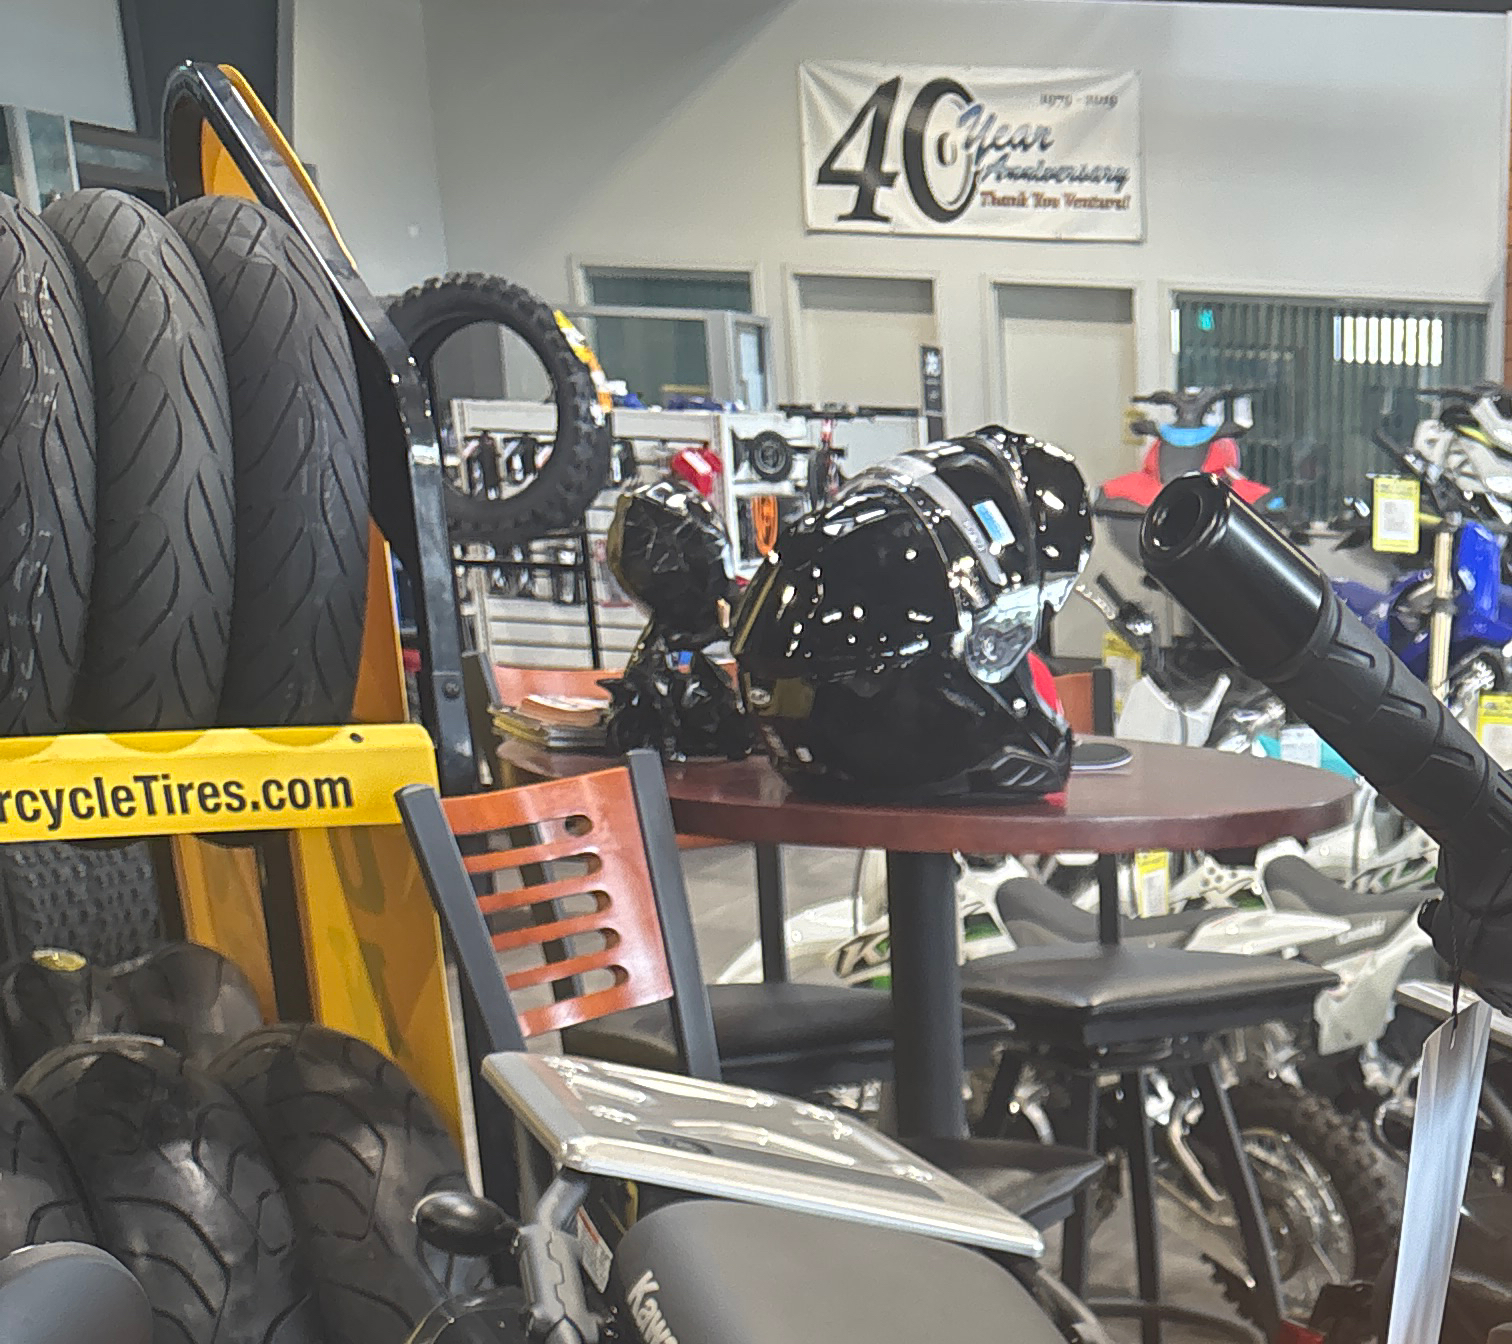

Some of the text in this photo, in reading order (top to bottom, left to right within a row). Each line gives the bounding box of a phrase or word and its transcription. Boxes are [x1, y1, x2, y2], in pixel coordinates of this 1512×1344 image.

[817, 75, 981, 223] 40
[958, 104, 1054, 162] Year
[979, 153, 1130, 194] Anniversary
[979, 190, 1028, 209] Thank
[1033, 191, 1060, 209] You
[0, 774, 354, 831] rcycleTires.com
